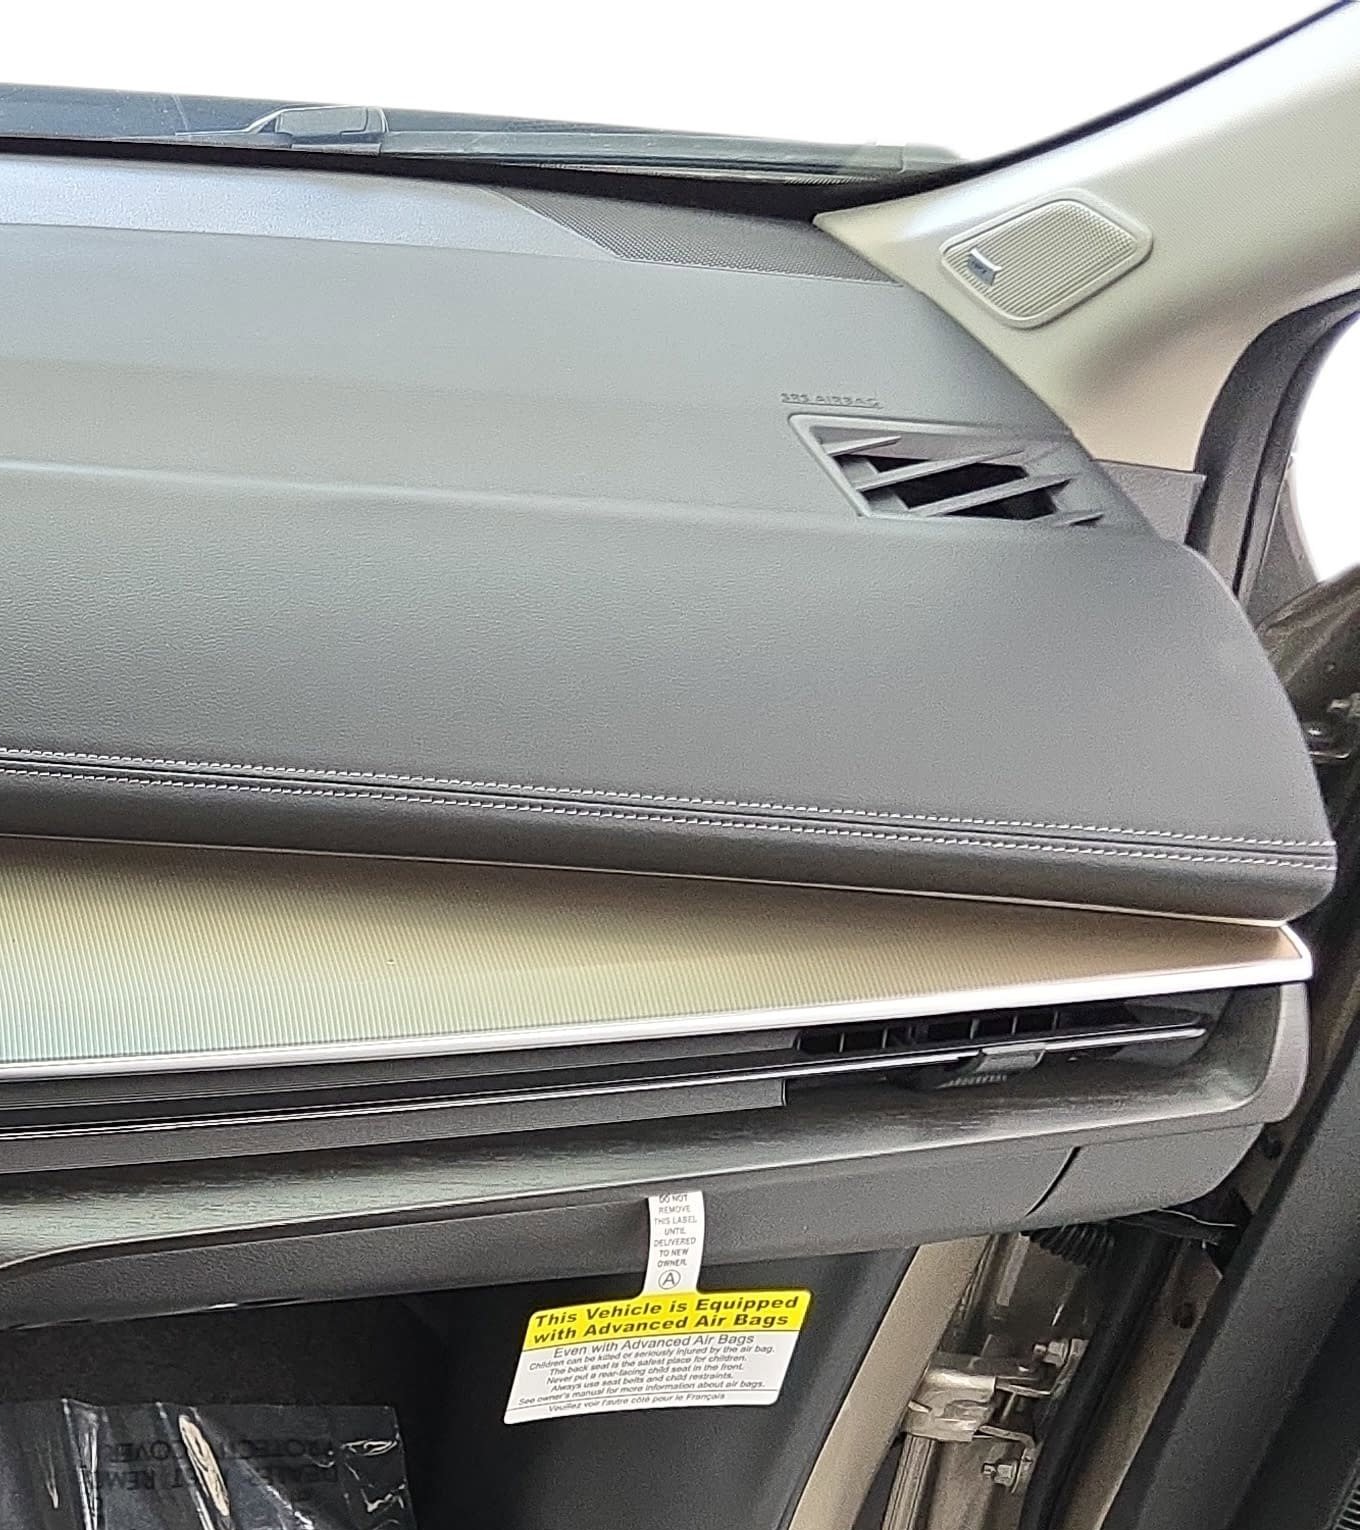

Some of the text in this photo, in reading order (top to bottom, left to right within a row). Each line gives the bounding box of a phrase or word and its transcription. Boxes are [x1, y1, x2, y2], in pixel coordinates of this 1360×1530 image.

[654, 1215, 698, 1225] THIS LABEL
[658, 1205, 692, 1214] REMOVE
[653, 1237, 697, 1248] DELIVERED
[664, 1227, 687, 1236] UNTIL
[659, 1248, 689, 1258] TO NEW
[535, 1295, 800, 1329] This Vehicle is Equipped
[533, 1313, 790, 1345] with Advanced Air Bags
[529, 1359, 565, 1371] Children
[566, 1357, 583, 1366] can
[584, 1354, 596, 1363] be
[598, 1352, 621, 1363] killed
[633, 1347, 674, 1359] seriously
[676, 1346, 707, 1357] injured
[709, 1345, 721, 1355] by
[723, 1345, 739, 1354] the
[740, 1344, 753, 1353] air
[754, 1344, 776, 1355] bag.
[553, 1333, 755, 1359] Even with Advanced Air Bags
[546, 1374, 574, 1385] Never
[671, 1362, 692, 1373] seat
[703, 1362, 719, 1371] the
[549, 1367, 567, 1377] The
[567, 1364, 589, 1375] back
[590, 1362, 610, 1371] seat
[666, 1356, 692, 1367] place
[708, 1354, 748, 1363] children.
[519, 1396, 536, 1405] See
[572, 1388, 605, 1399] manual
[620, 1384, 644, 1394] more
[697, 1379, 724, 1389] about
[551, 1382, 582, 1393] Always
[601, 1378, 621, 1387] seat
